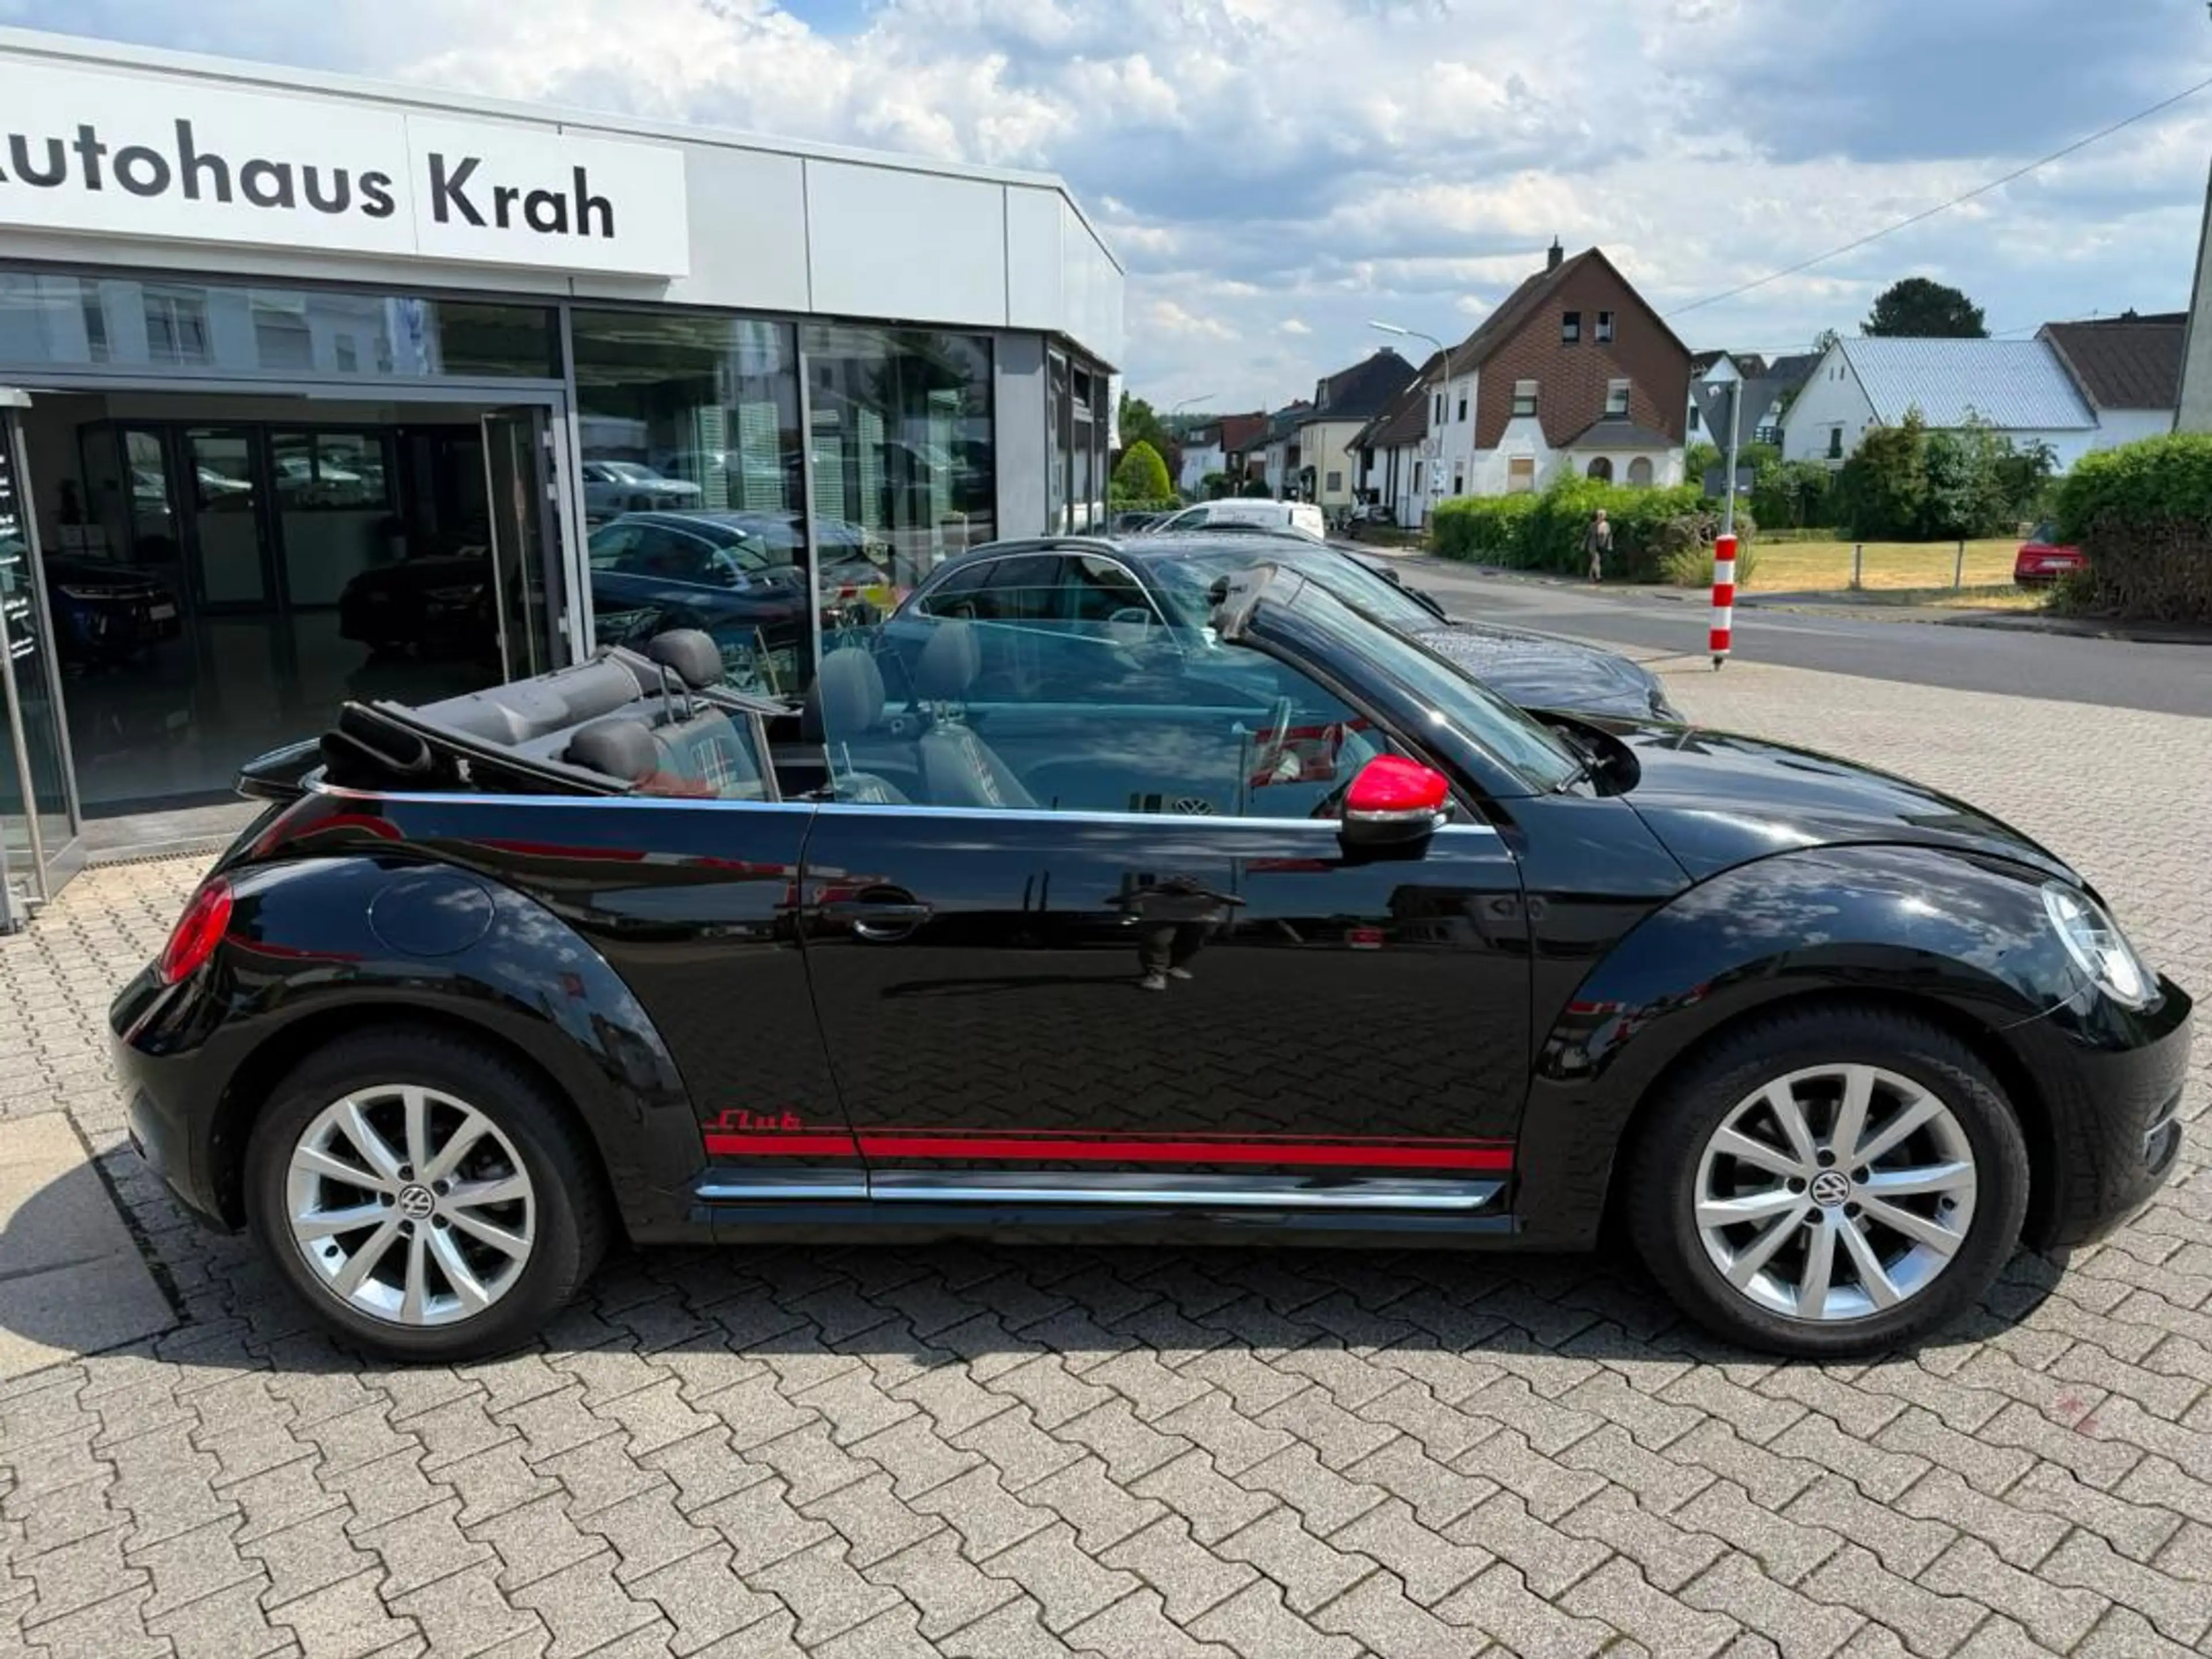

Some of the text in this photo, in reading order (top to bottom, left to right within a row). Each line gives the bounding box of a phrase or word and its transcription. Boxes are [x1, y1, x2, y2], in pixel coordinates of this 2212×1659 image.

[0, 119, 615, 238] utohaus Krah
[717, 1107, 802, 1131] Club
